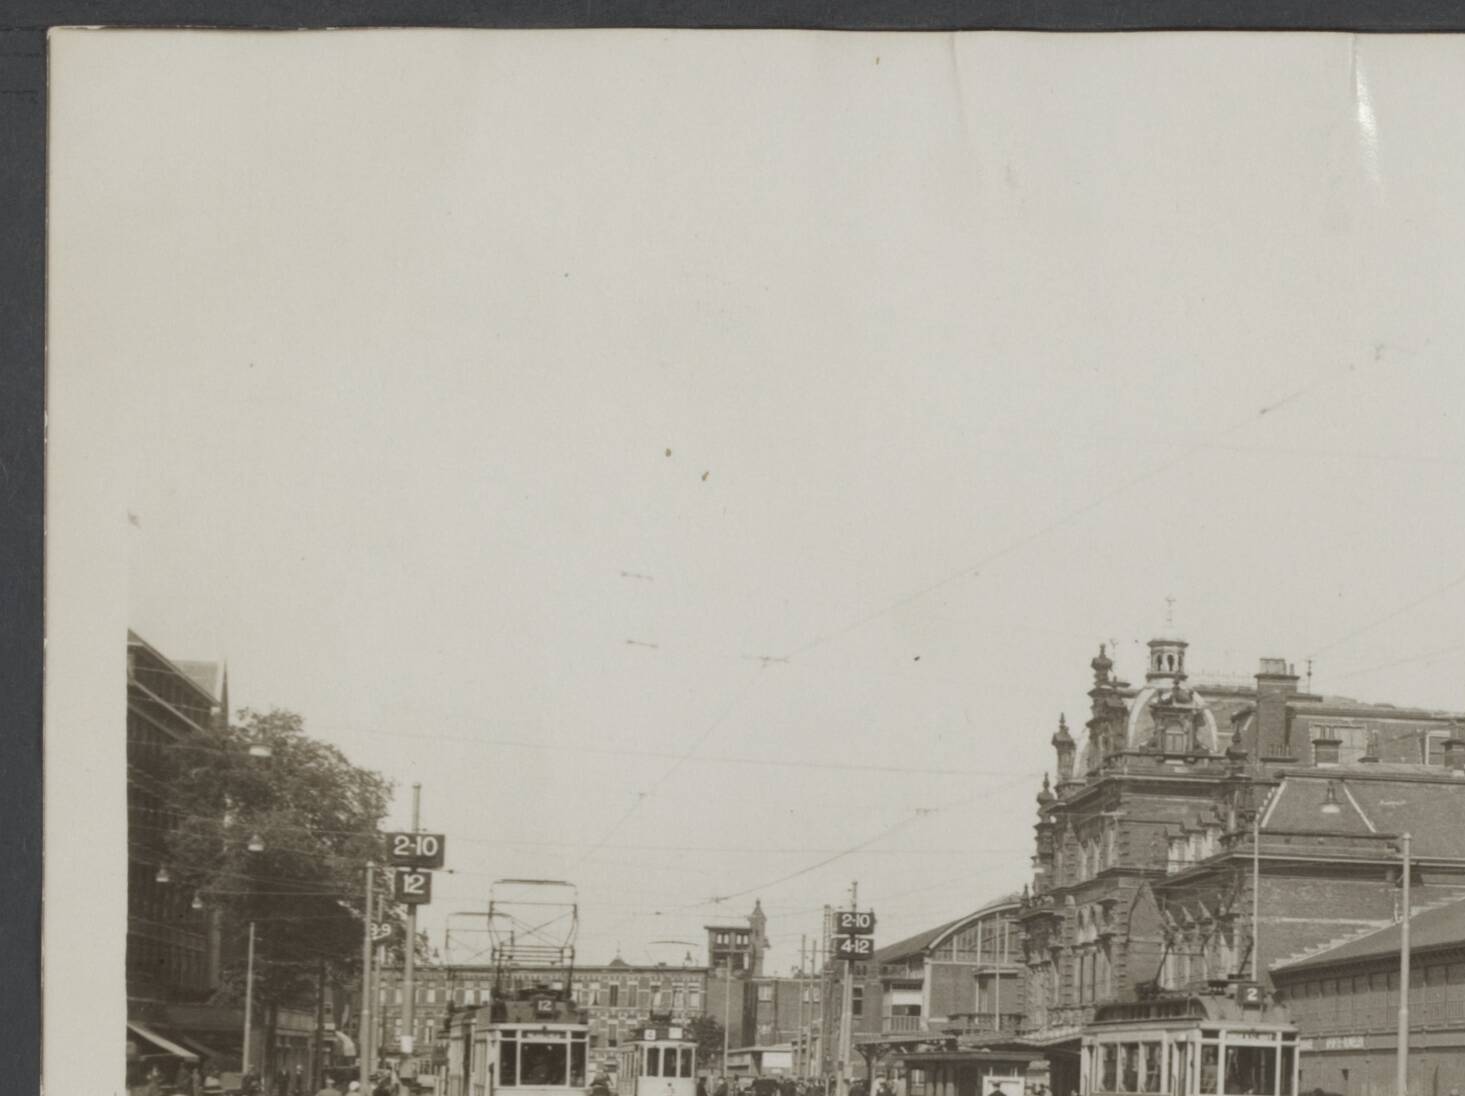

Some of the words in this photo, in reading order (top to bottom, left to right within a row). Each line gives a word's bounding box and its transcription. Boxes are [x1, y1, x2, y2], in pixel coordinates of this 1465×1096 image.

[393, 835, 438, 857] 2-10
[402, 873, 425, 895] 12
[841, 913, 871, 928] 2-10
[840, 939, 870, 954] 4-12
[1246, 987, 1259, 1002] 2
[537, 999, 553, 1012] 12
